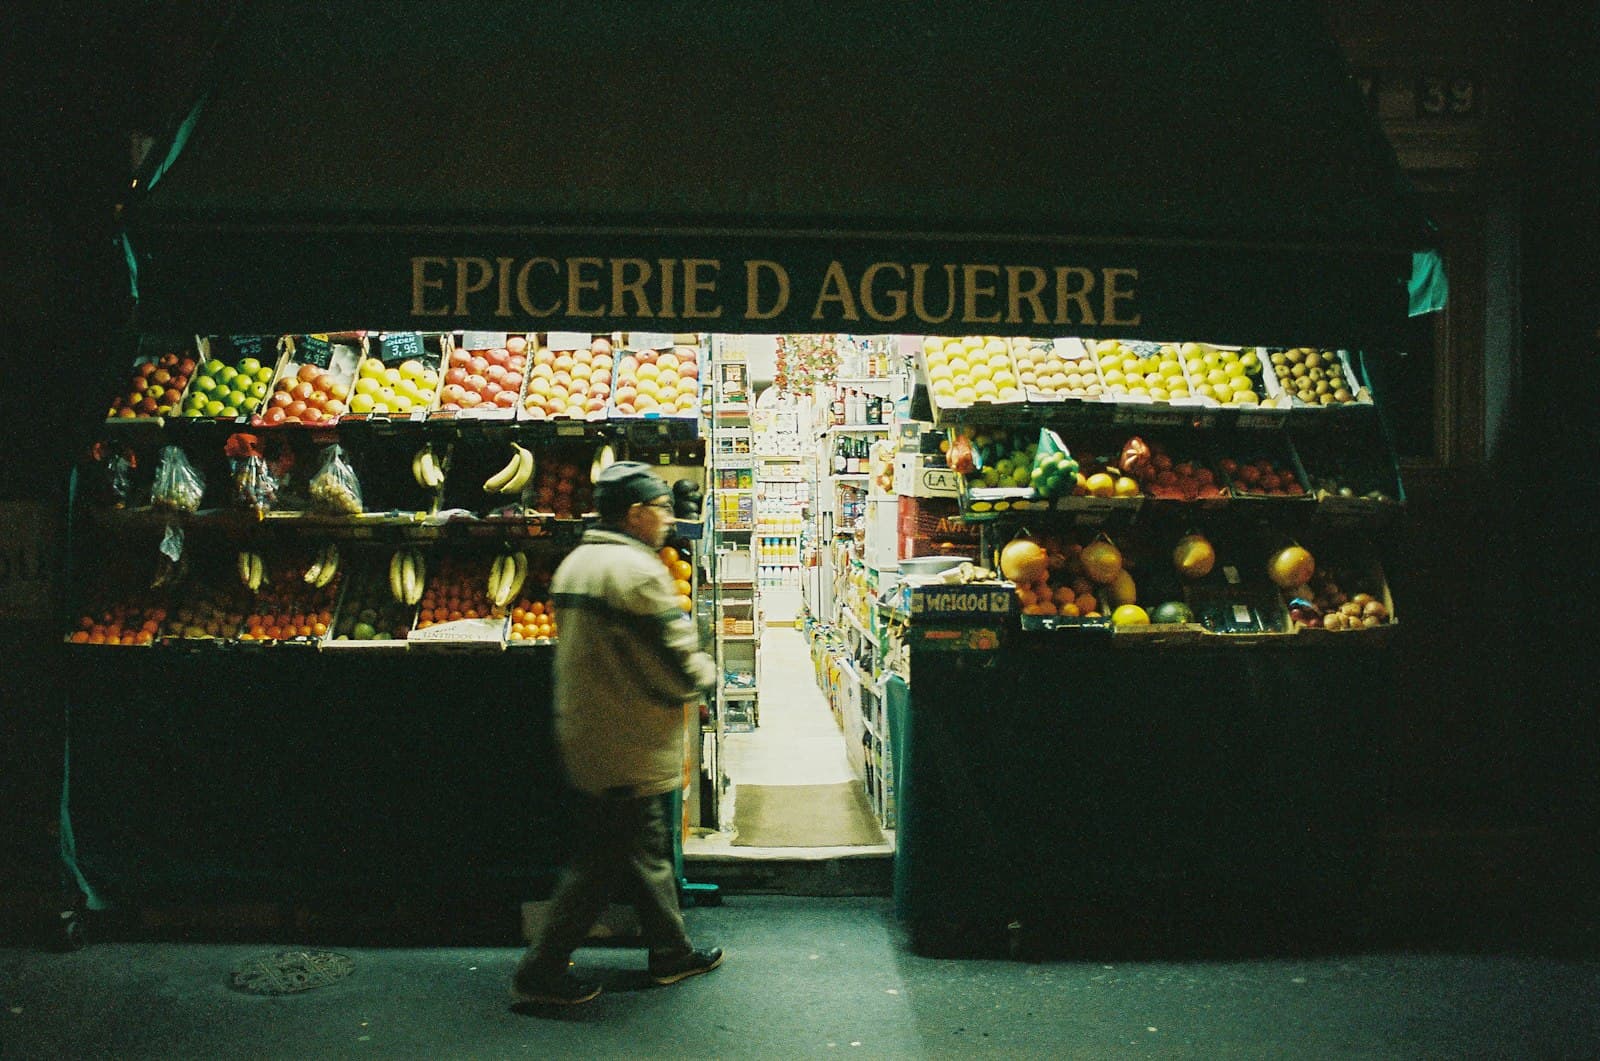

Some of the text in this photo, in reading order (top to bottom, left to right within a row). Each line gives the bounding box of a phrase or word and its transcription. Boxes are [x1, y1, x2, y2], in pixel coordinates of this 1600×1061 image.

[409, 256, 1141, 325] EPICERIE D AGUERRE
[928, 474, 946, 487] LA
[926, 593, 988, 613] PODIUM
